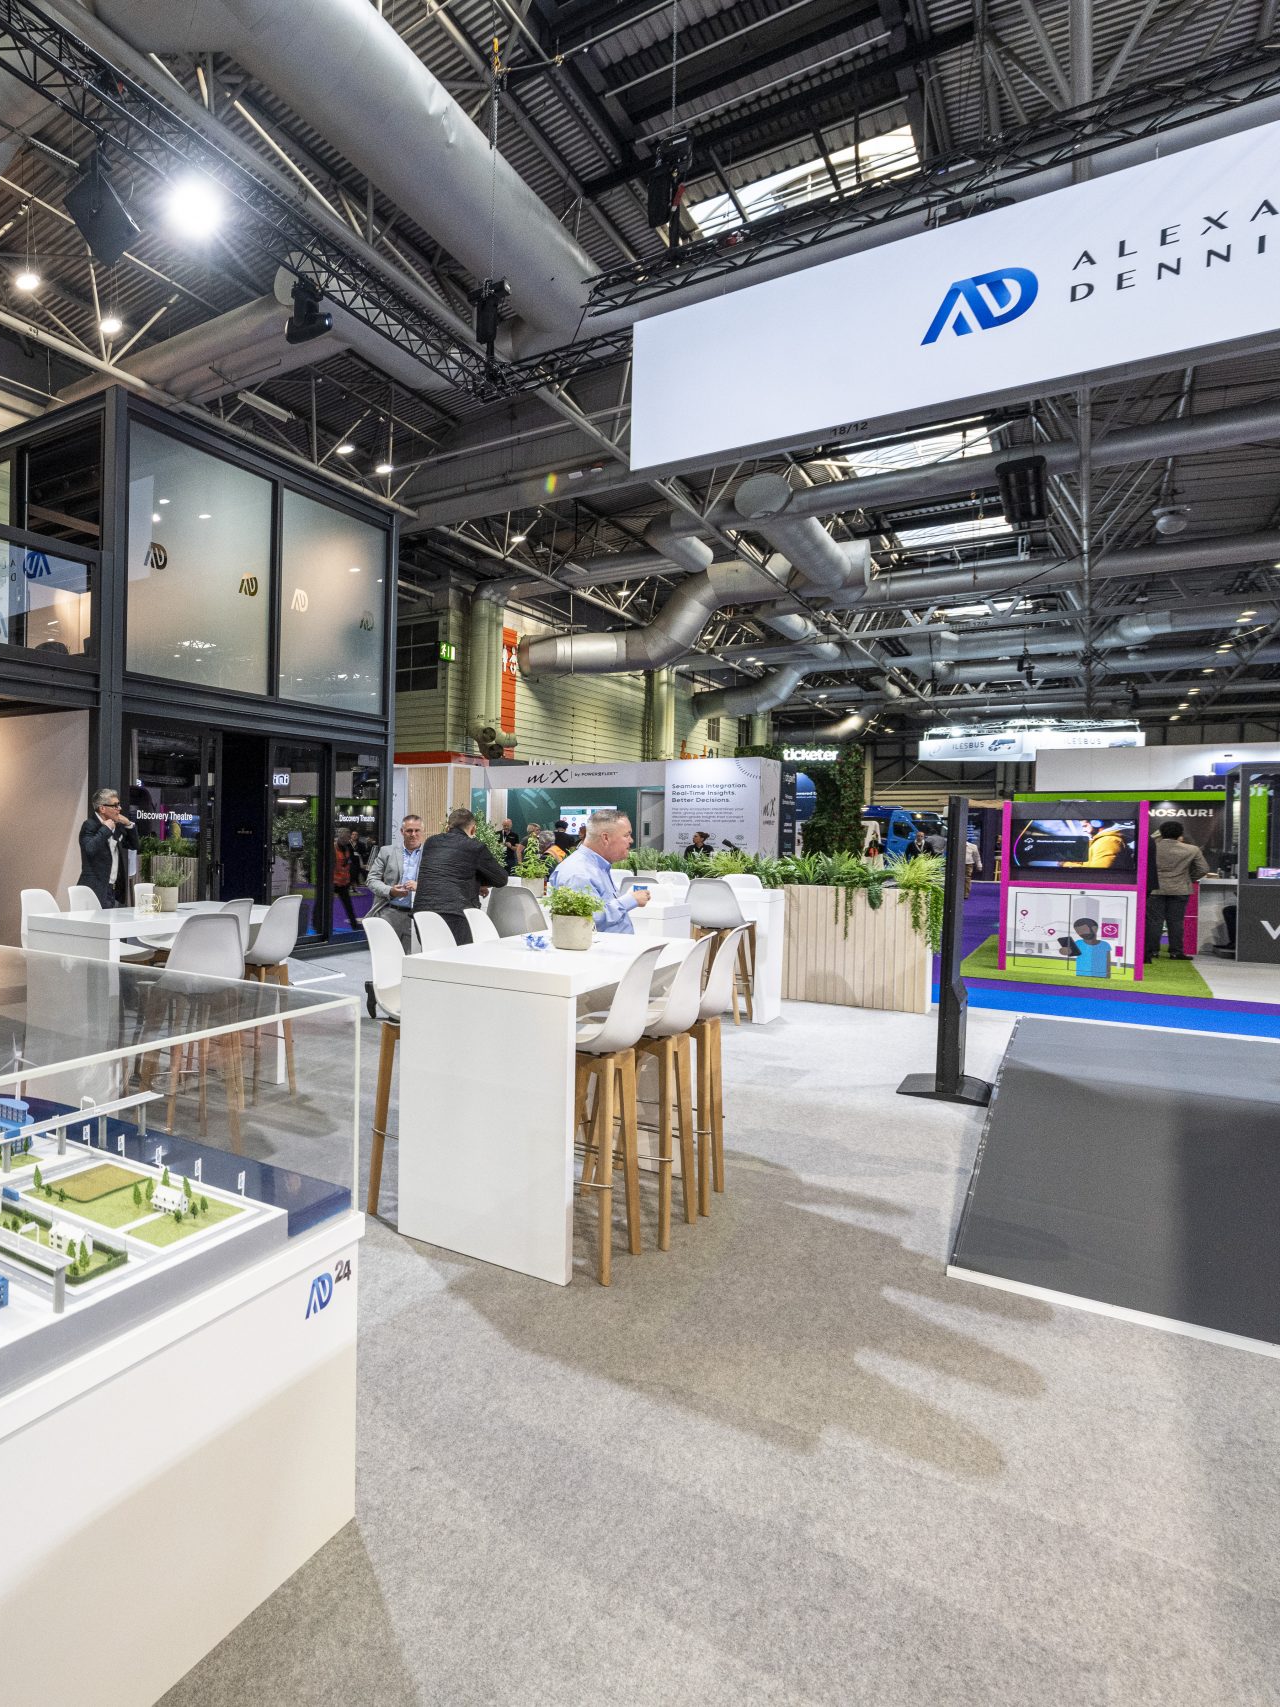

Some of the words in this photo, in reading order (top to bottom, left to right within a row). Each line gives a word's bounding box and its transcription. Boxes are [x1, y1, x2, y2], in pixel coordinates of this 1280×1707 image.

[831, 421, 869, 437] 18/12
[782, 748, 839, 761] ticketer
[136, 810, 169, 821] Discovery
[169, 811, 193, 821] Theatre
[339, 814, 360, 823] Discovery
[360, 815, 375, 823] Theatre
[1148, 808, 1214, 818] NOSAUR!
[334, 1259, 352, 1284] 24
